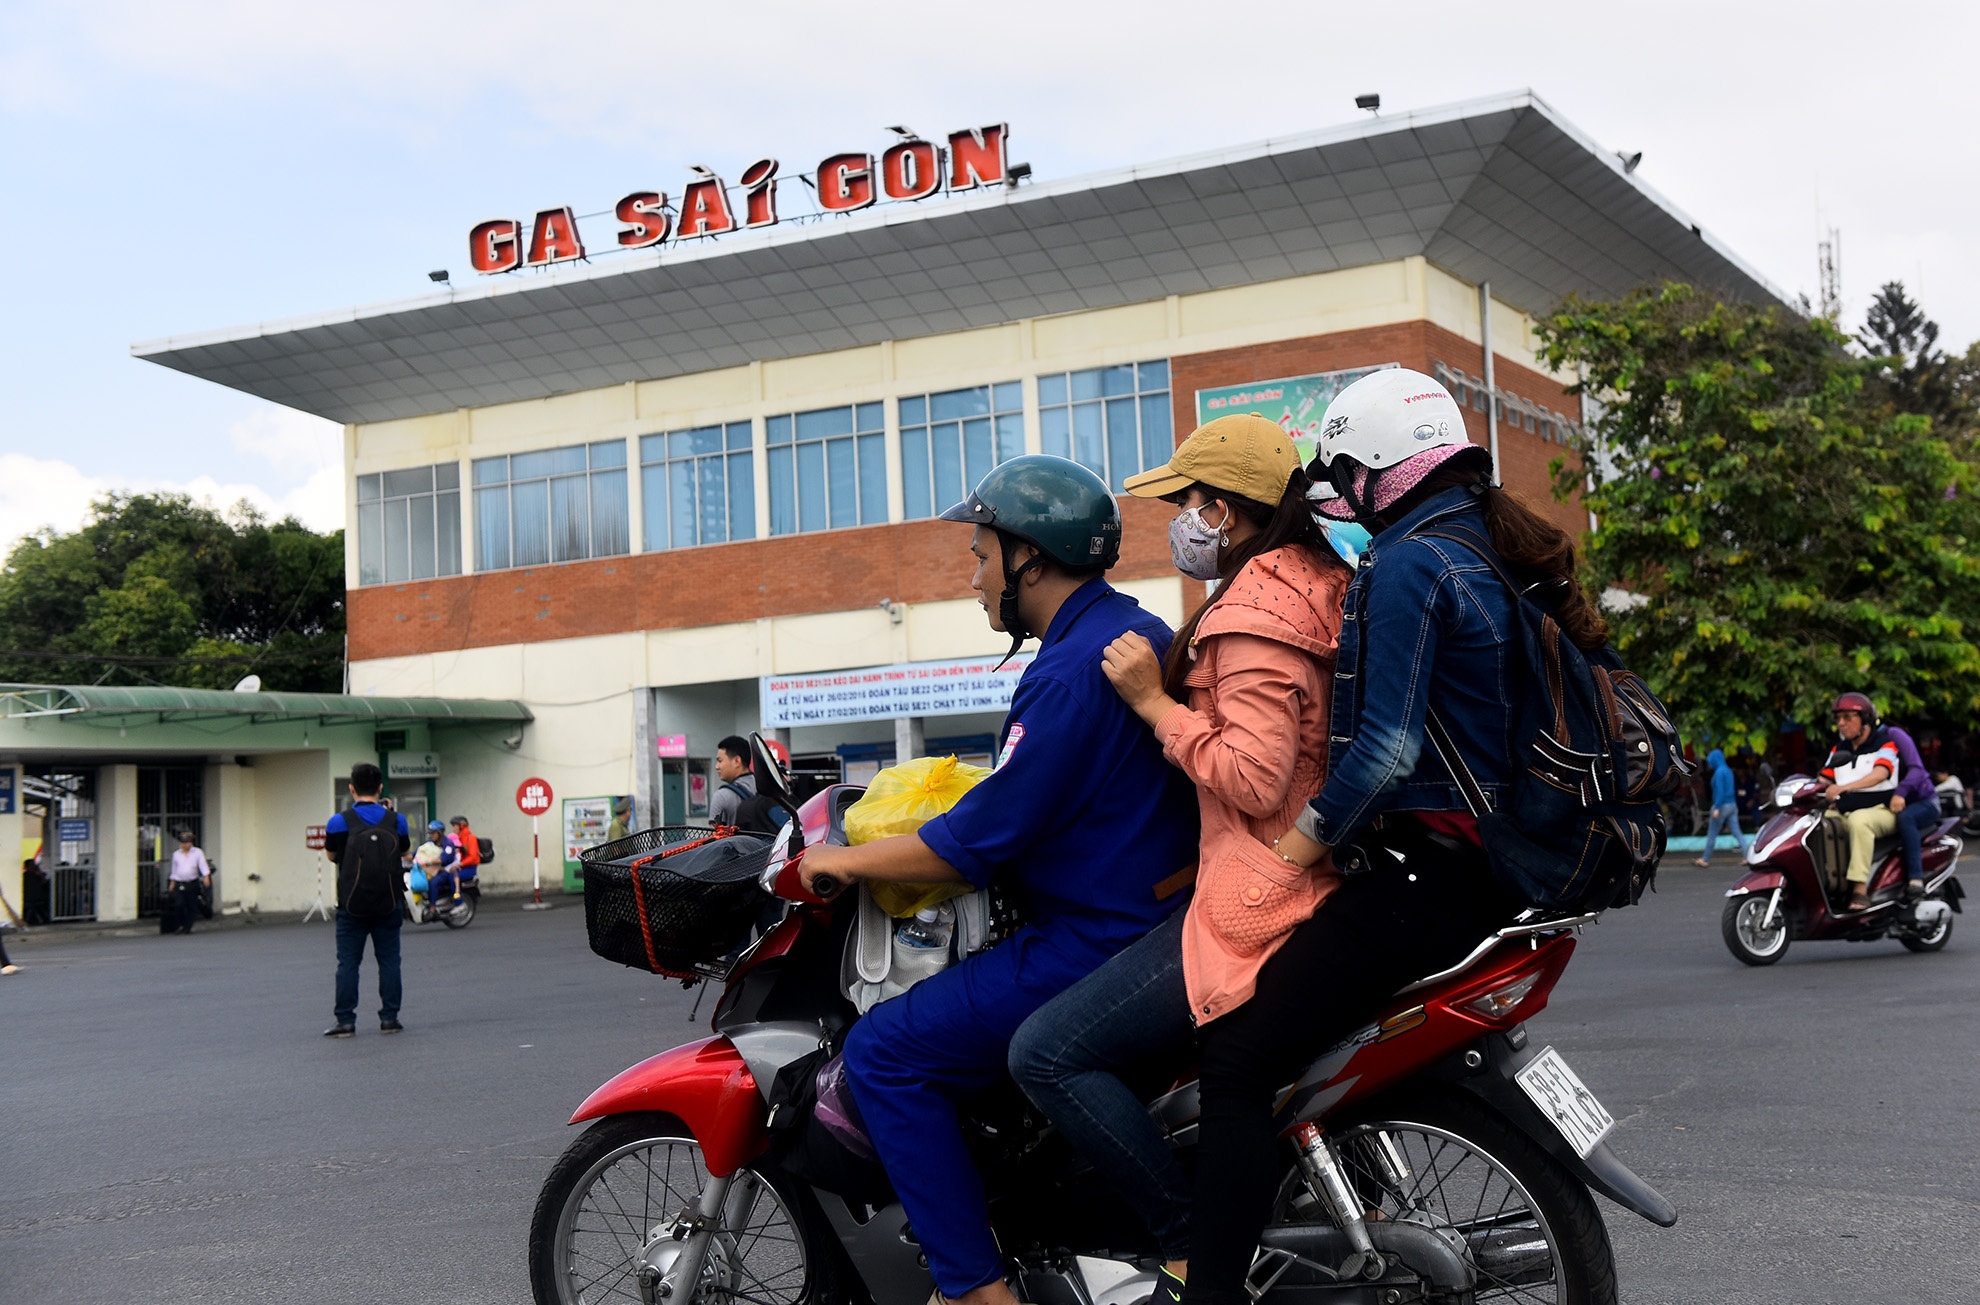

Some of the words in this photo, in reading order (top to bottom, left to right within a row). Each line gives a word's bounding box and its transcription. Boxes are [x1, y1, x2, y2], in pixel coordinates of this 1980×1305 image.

[469, 205, 585, 275] GA
[816, 122, 1009, 212] GÒN
[803, 693, 824, 703] NGÀY
[868, 687, 890, 697] ĐOÀN
[892, 685, 908, 695] TÀU
[911, 685, 930, 695] SE22
[932, 684, 954, 694] CHẠY
[971, 679, 984, 689] SÀI
[987, 677, 1004, 688] GÒN
[803, 708, 824, 719] NGÀY
[869, 702, 891, 713] ĐOÀN
[893, 701, 909, 711] TÀU
[912, 701, 930, 711] SE21
[933, 700, 955, 709] CHẠY
[972, 696, 991, 705] VINH
[391, 764, 437, 774] Vietcombank
[1526, 1057, 1575, 1109] 59-F1
